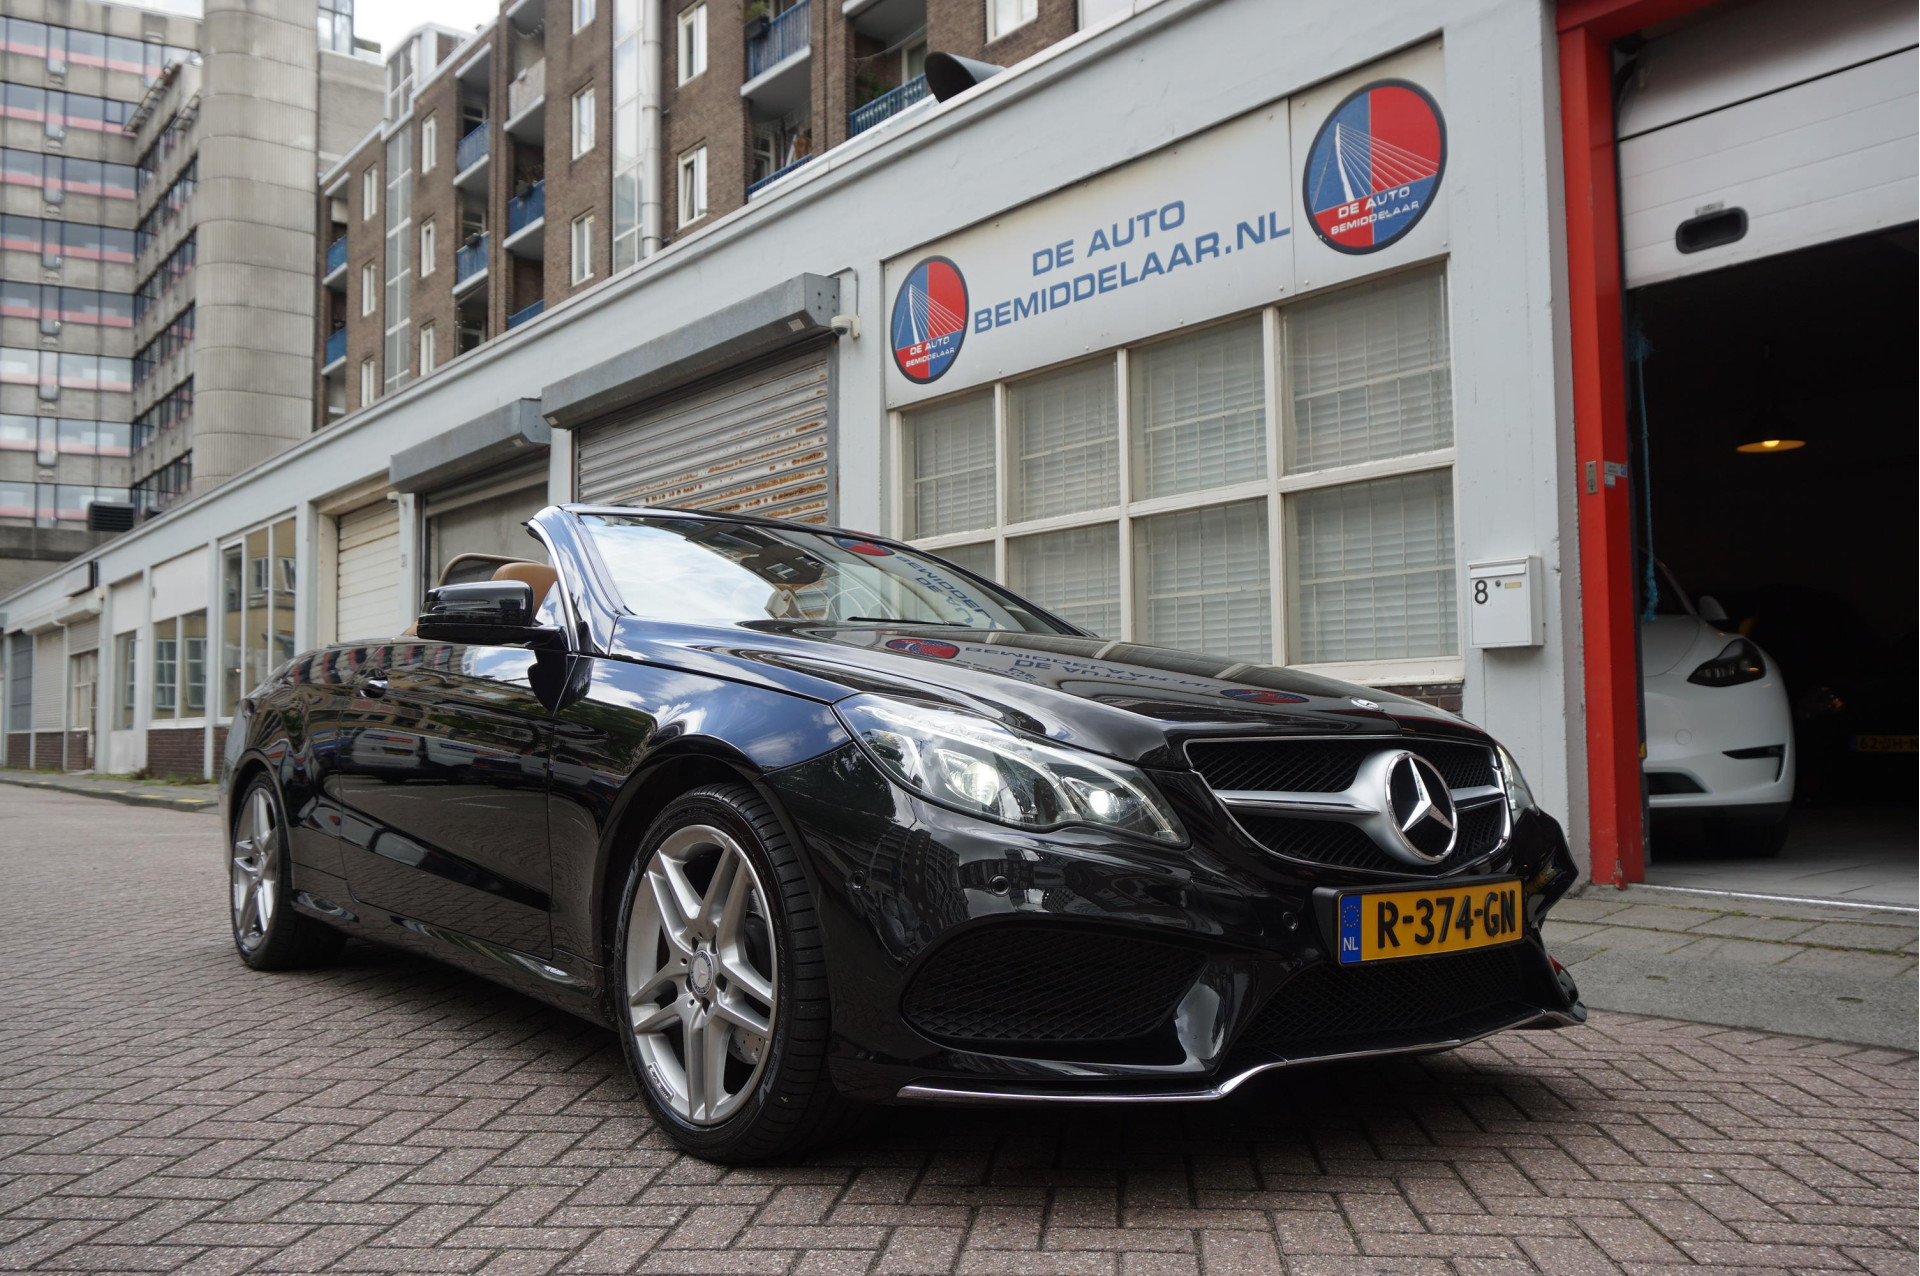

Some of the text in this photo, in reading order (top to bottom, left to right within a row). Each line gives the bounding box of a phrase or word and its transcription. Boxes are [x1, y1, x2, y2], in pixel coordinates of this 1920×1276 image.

[1331, 201, 1420, 236] BEMIDDELAAR
[1338, 186, 1410, 219] DE AUTO
[1032, 200, 1185, 277] DE AUTO
[974, 211, 1291, 335] BEMIDDELAAR.NL
[905, 347, 955, 368] BEMIDDELAAR
[909, 336, 950, 356] DE AUTO
[1474, 580, 1488, 605] 8
[1343, 889, 1516, 952] NL R-374-GN
